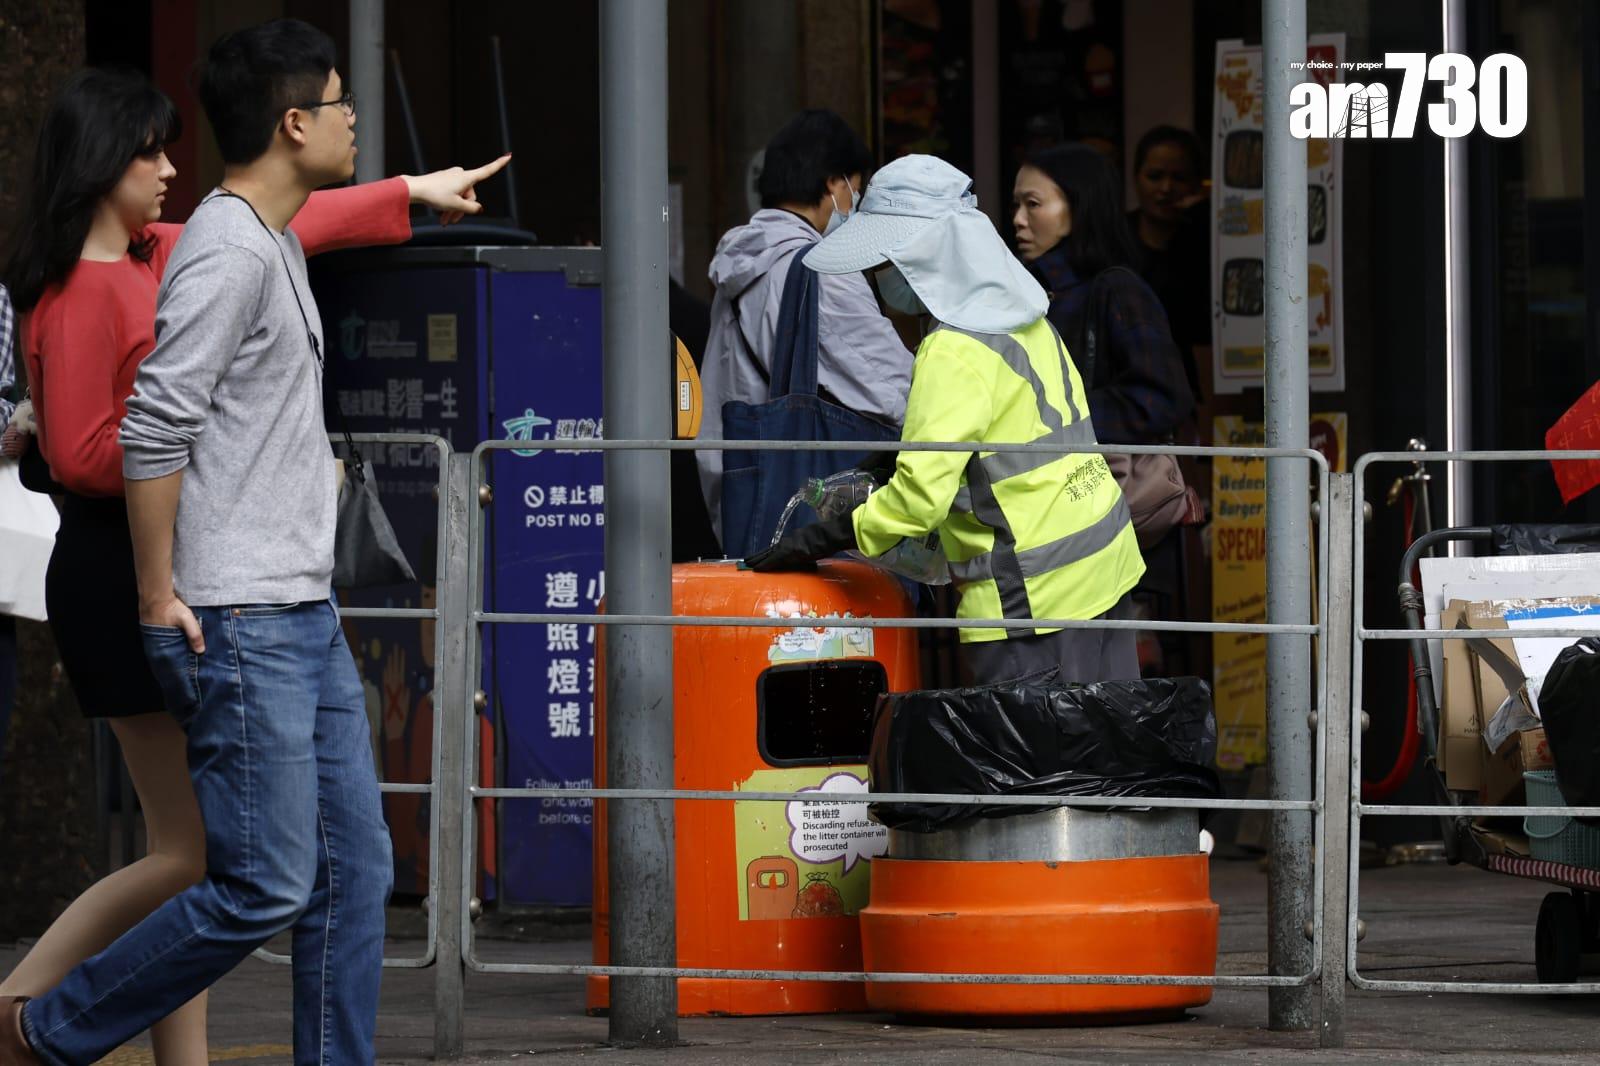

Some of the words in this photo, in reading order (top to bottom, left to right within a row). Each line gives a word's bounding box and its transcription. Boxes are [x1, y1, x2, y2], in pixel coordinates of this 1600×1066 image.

[526, 514, 565, 527] POST
[569, 513, 591, 526] NO
[545, 571, 581, 738] 遵照燈號
[540, 812, 581, 825] before
[803, 819, 845, 830] Discarding
[847, 818, 869, 829] refuse
[803, 833, 817, 841] the
[819, 832, 838, 841] litter
[840, 829, 874, 840] container
[803, 842, 848, 853] prosecuted
